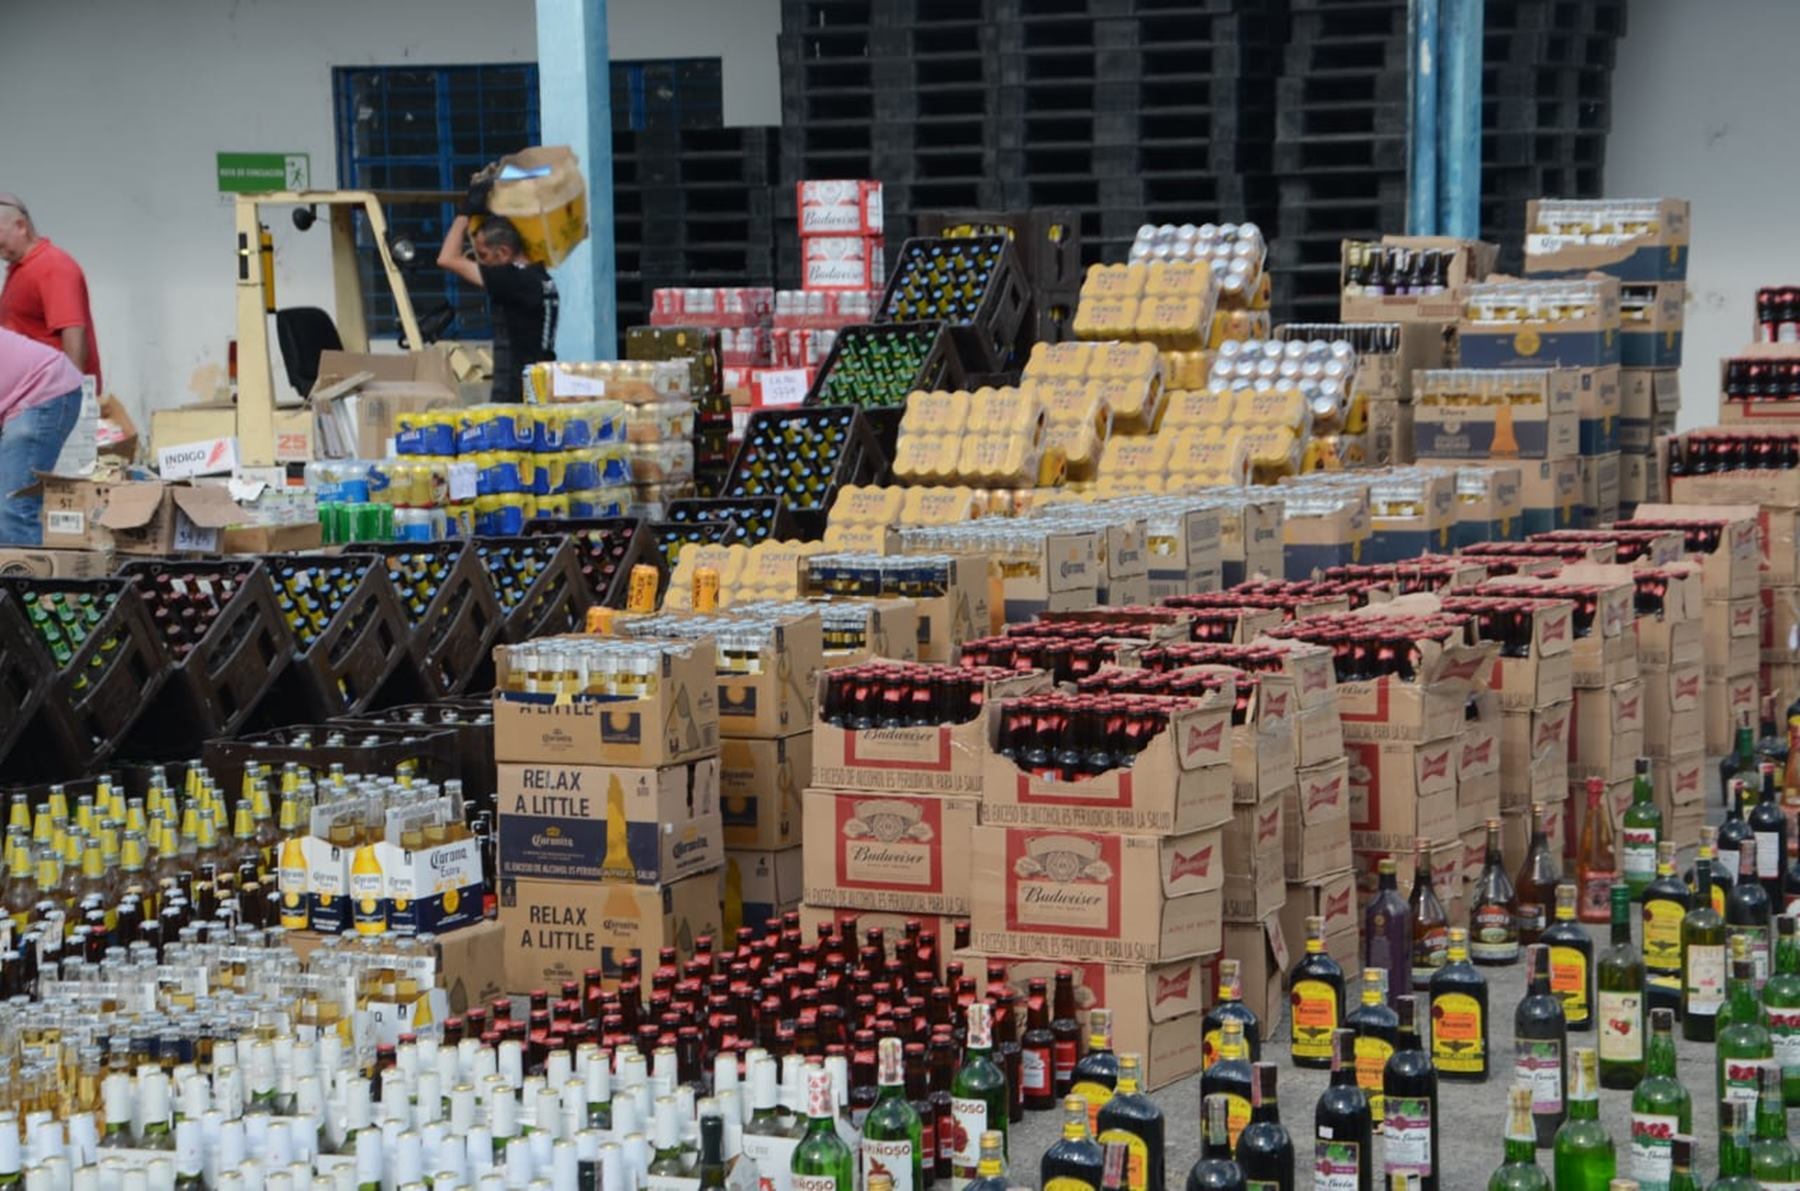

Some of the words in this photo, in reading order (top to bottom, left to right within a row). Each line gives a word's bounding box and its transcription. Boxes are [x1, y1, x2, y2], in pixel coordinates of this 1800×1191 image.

[277, 434, 307, 450] 25
[164, 449, 206, 466] INDIGO
[523, 769, 581, 791] RELAX
[639, 776, 645, 785] 4
[515, 795, 526, 813] A
[532, 797, 590, 817] LITTLE
[1117, 810, 1135, 829] PARA
[1137, 811, 1145, 830] LA
[431, 848, 467, 869] Corona
[854, 846, 925, 865] Budweiser
[1021, 886, 1103, 904] Budweiser
[530, 905, 587, 926] RELAX
[520, 929, 532, 948] A
[539, 931, 595, 951] LITTLE
